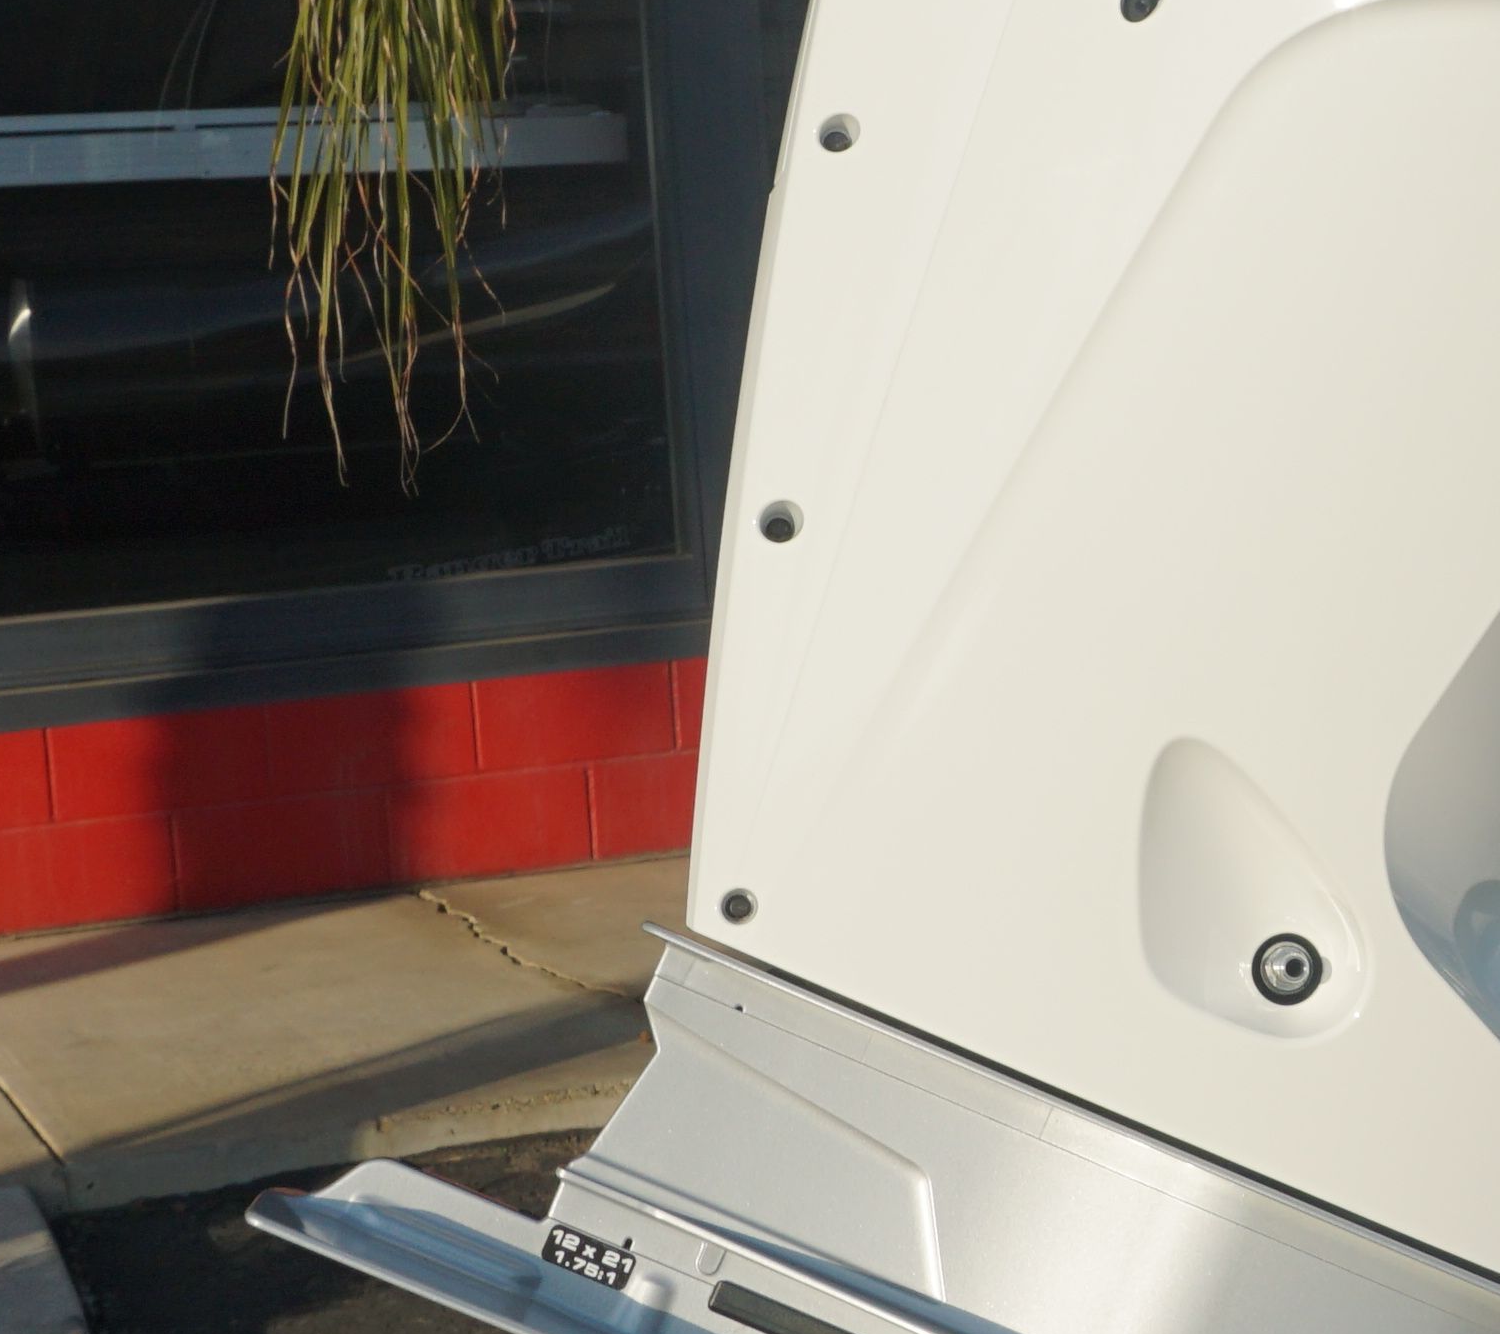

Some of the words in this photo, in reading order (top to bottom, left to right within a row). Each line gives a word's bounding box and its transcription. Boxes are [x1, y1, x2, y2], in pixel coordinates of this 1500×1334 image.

[552, 1229, 581, 1252] 12
[581, 1244, 598, 1259] x
[601, 1249, 634, 1274] 21
[554, 1250, 617, 1285] 1.75:1
